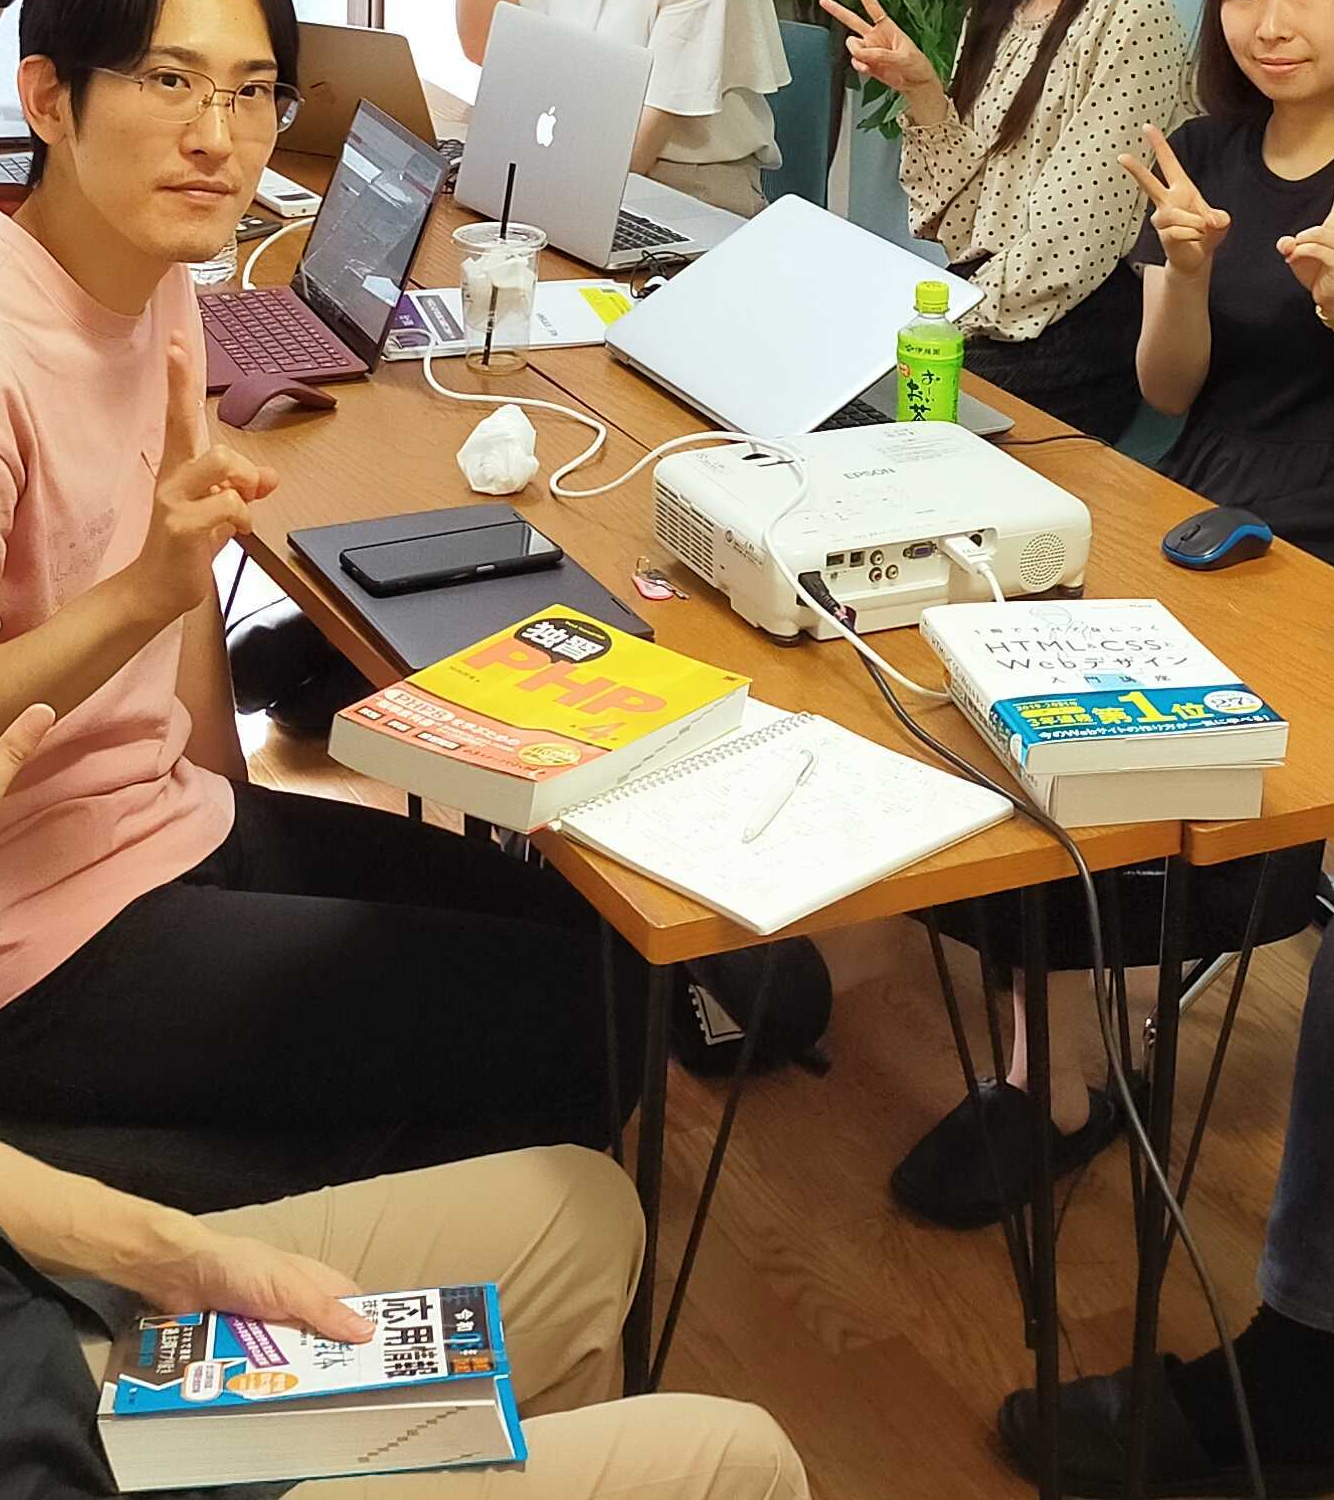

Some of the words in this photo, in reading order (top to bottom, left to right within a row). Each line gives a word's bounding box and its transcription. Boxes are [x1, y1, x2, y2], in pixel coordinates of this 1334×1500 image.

[842, 467, 896, 479] EPSON
[520, 621, 605, 661] 独習
[461, 637, 668, 715] PHP
[380, 1294, 440, 1379] 応用情報
